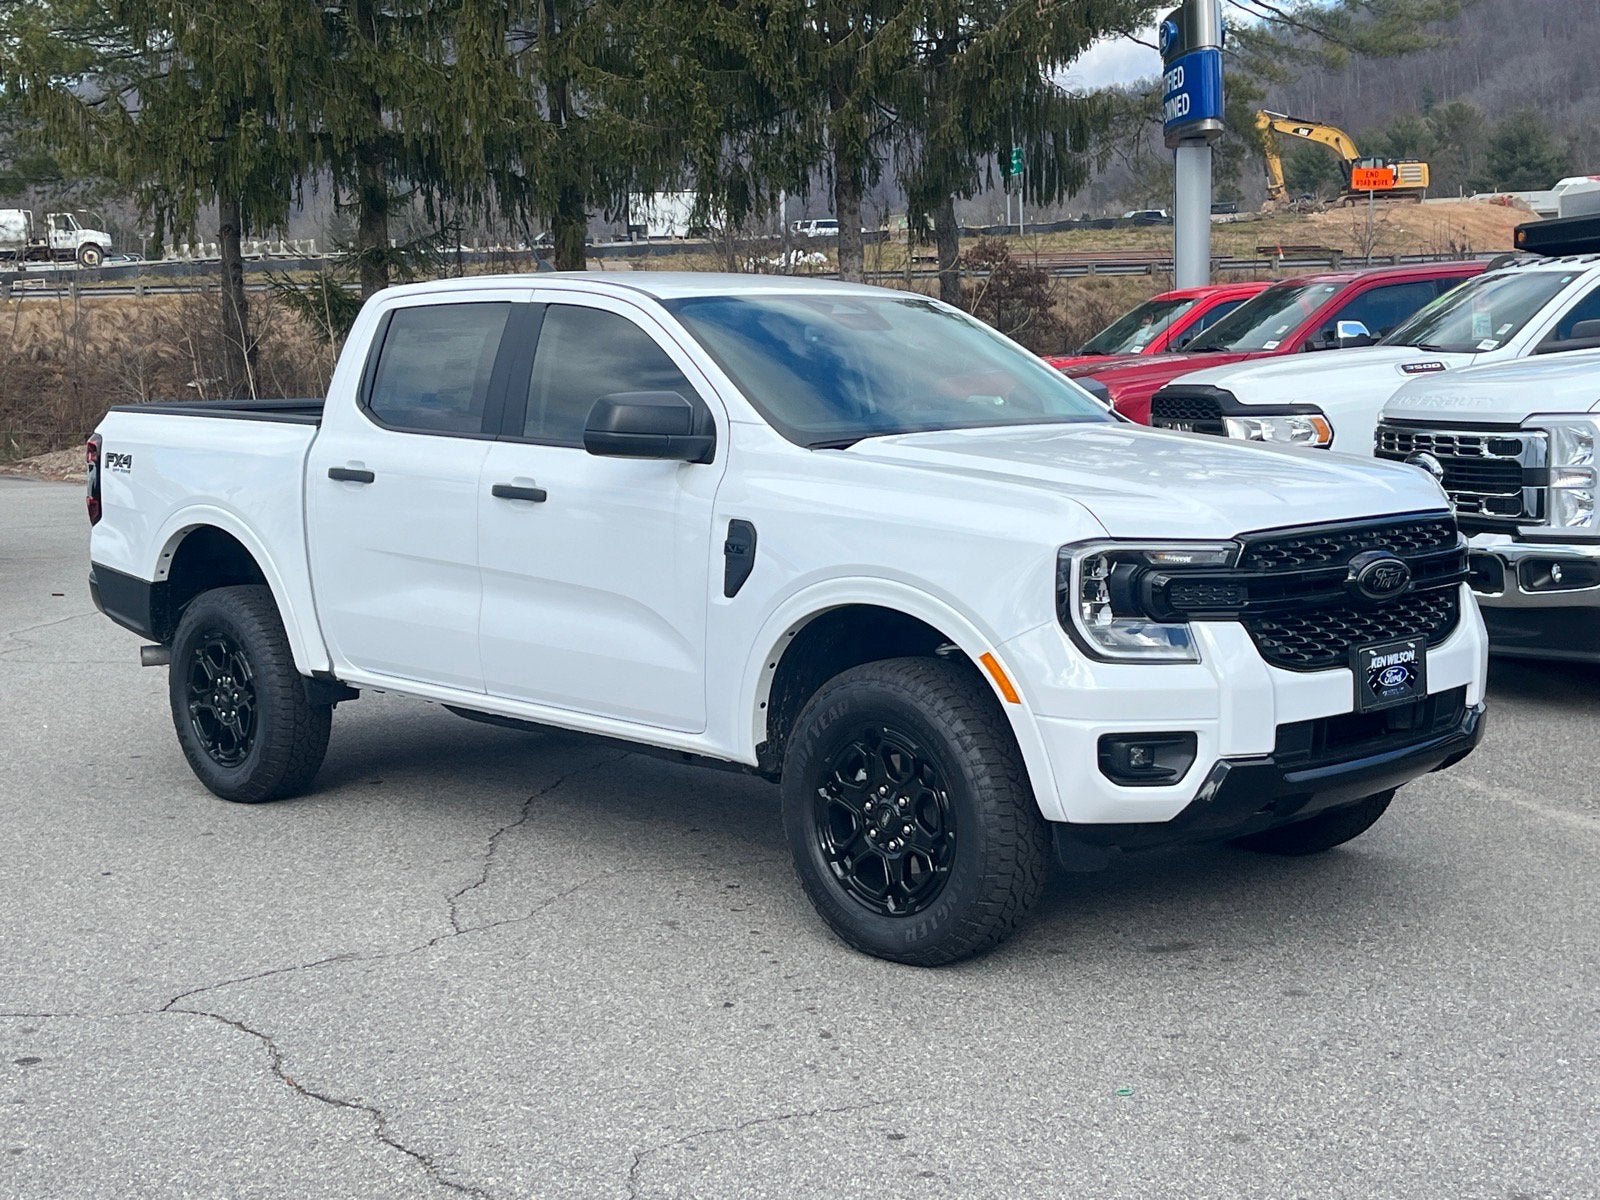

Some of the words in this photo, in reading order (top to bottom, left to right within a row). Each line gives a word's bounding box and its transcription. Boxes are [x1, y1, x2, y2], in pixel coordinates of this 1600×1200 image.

[1365, 170, 1380, 178] END
[1406, 362, 1441, 370] 3500
[105, 452, 132, 468] FX4
[1371, 655, 1387, 669] KEN
[1386, 649, 1415, 666] WILSON
[1384, 669, 1403, 684] Ford
